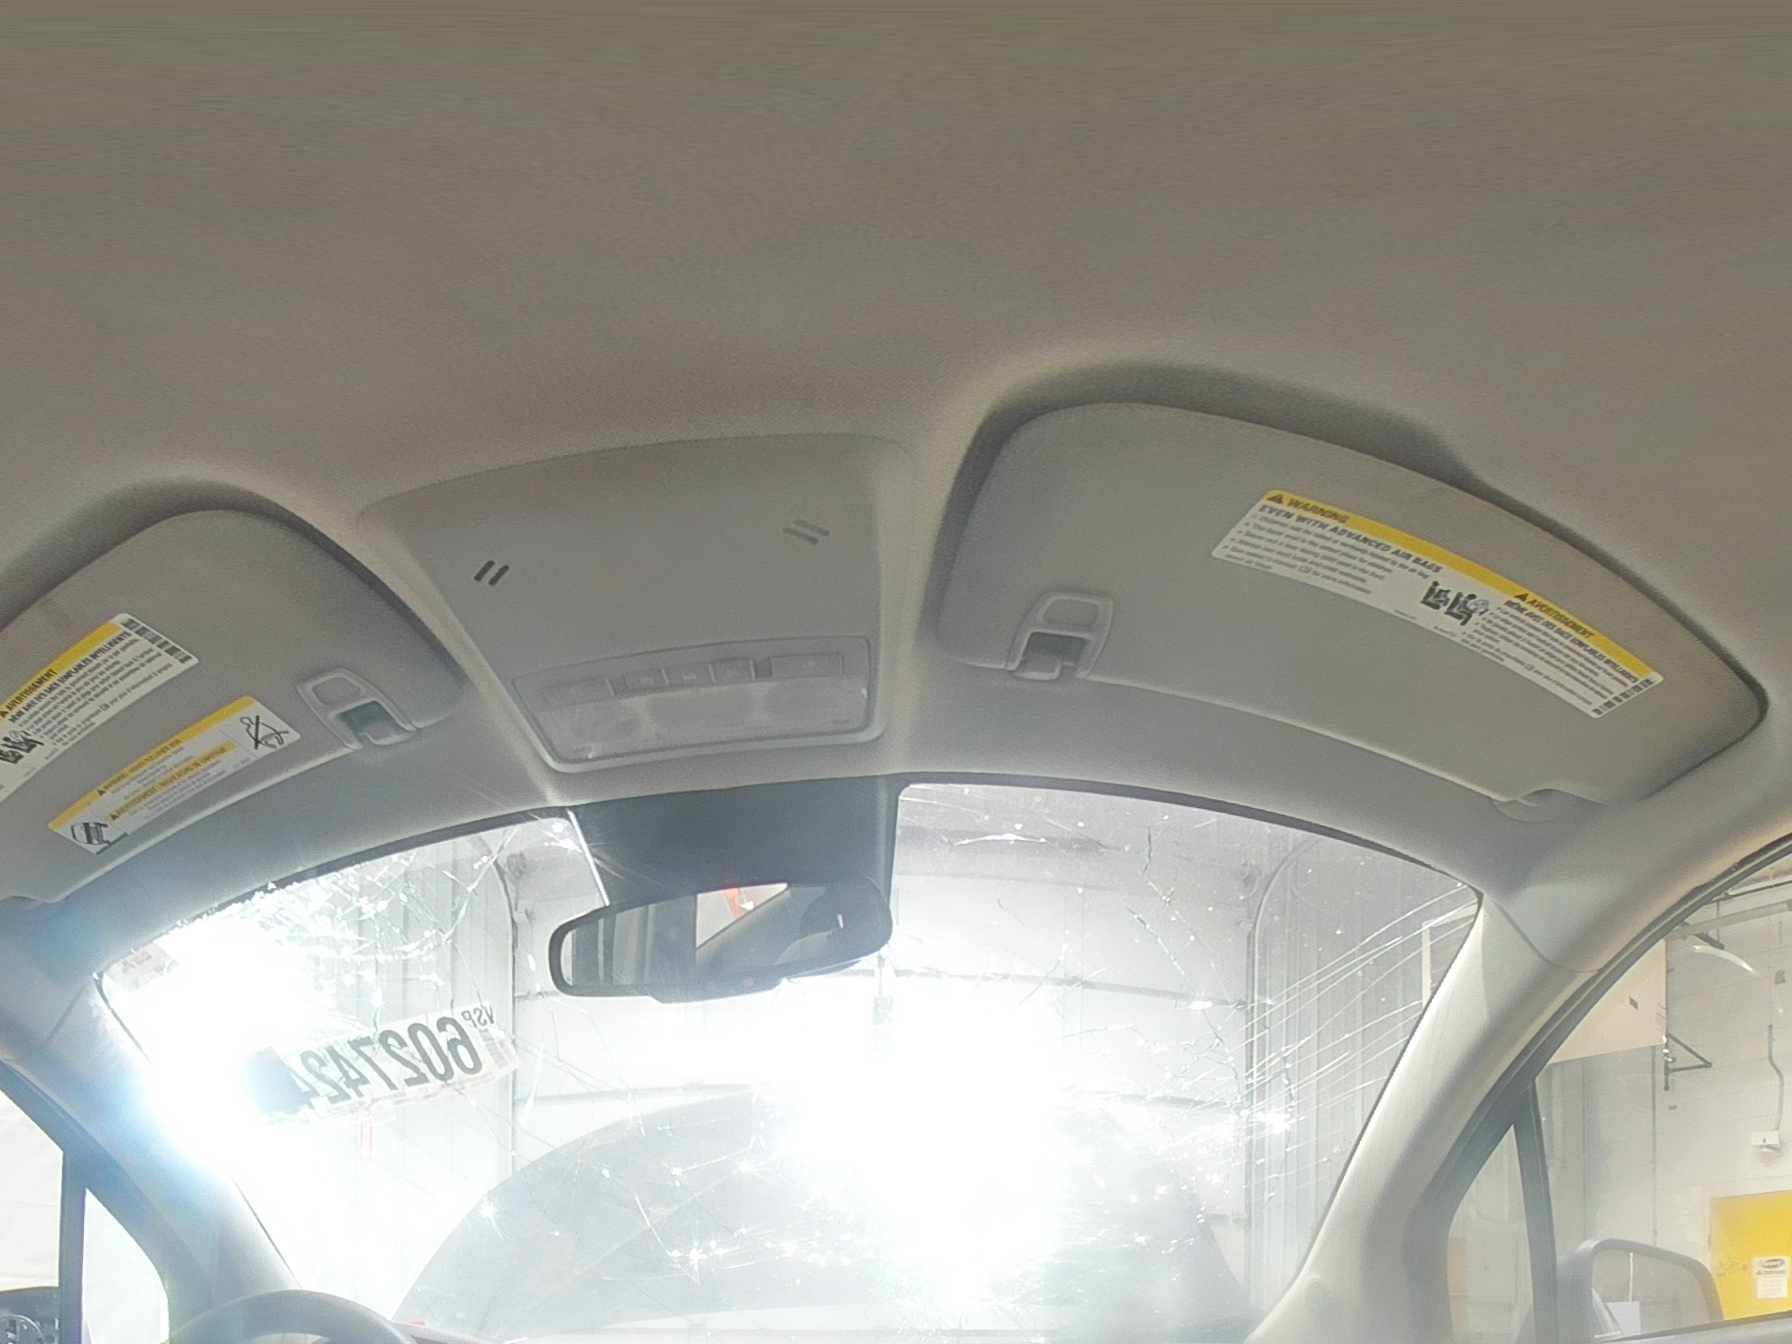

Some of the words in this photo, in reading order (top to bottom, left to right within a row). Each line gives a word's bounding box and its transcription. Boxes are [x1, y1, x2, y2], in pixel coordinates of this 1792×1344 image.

[1258, 503, 1295, 519] EVEN
[1293, 514, 1330, 530] WITH
[1328, 525, 1392, 553] ADVANCED
[1390, 547, 1413, 561] AIR
[1410, 556, 1443, 574] BAGS
